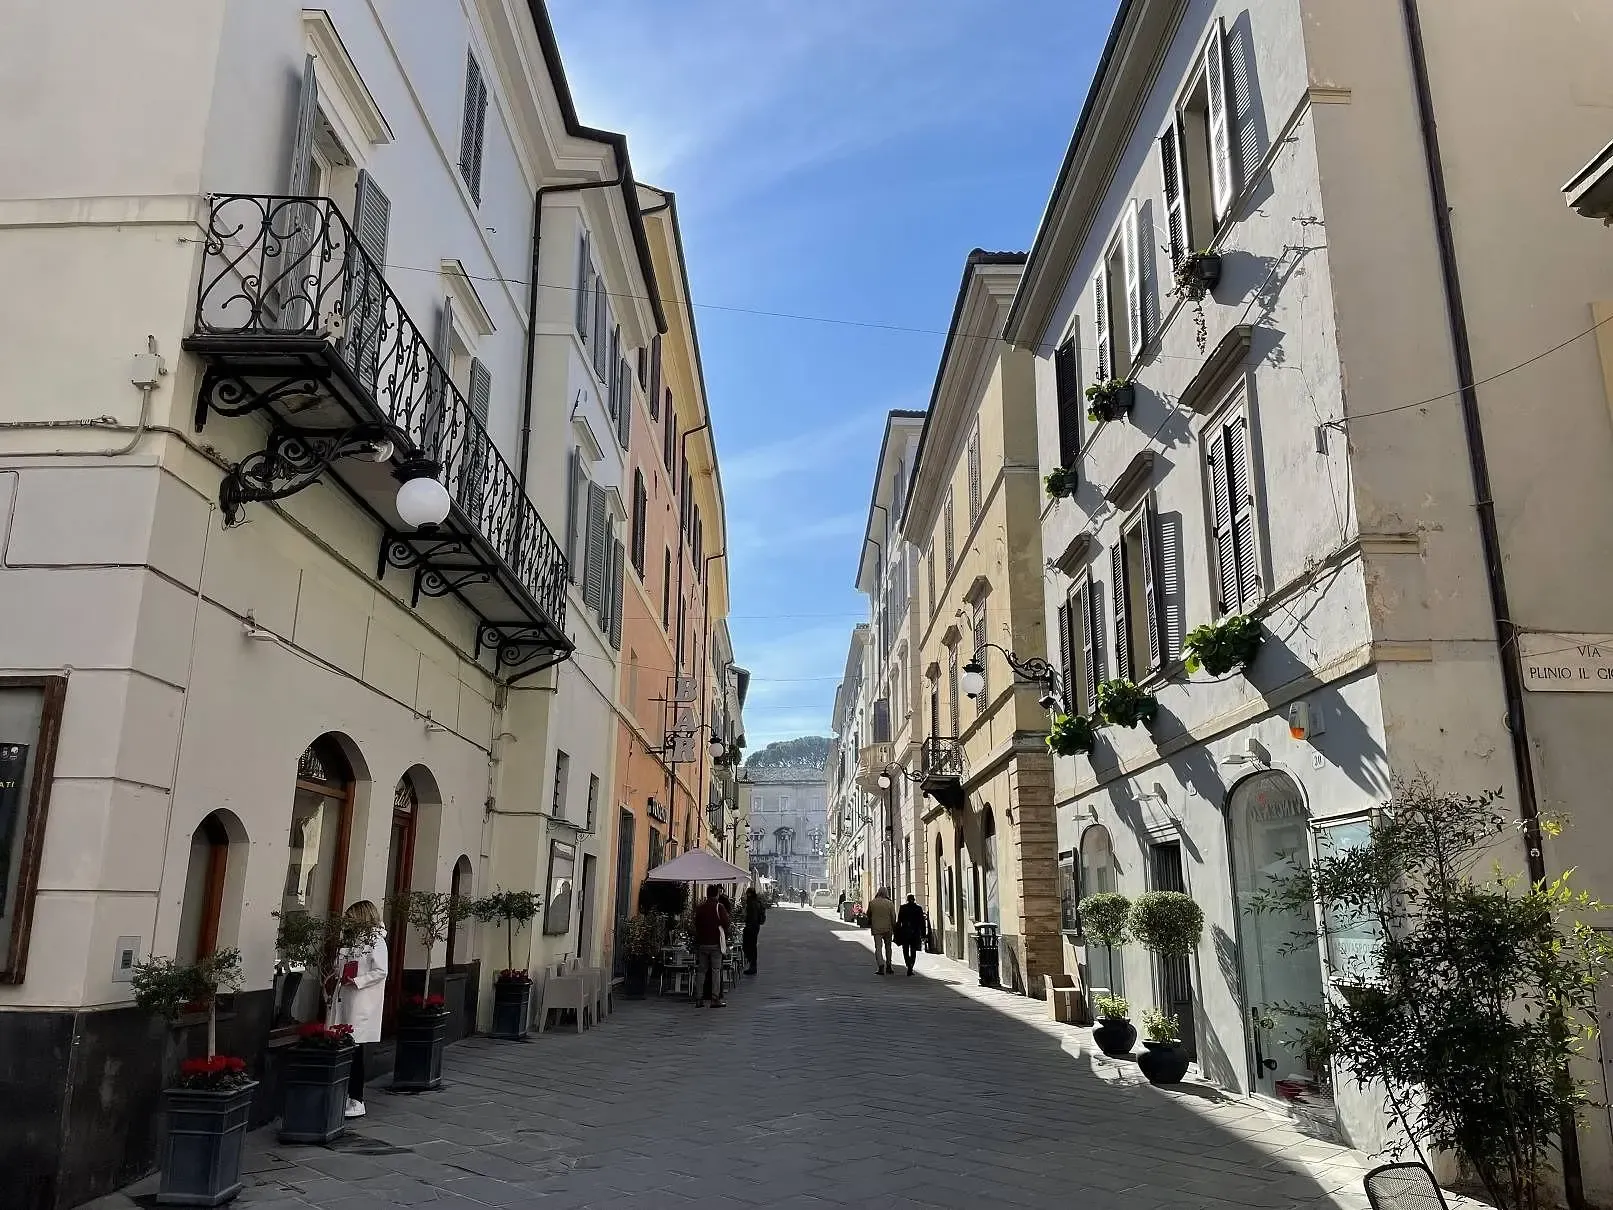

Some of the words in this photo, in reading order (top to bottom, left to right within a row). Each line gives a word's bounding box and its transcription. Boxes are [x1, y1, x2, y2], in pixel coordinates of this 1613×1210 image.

[1577, 644, 1601, 658] VIA
[1530, 666, 1572, 679] PLINIO
[1578, 667, 1590, 680] IL
[1597, 667, 1613, 680] GI
[673, 677, 697, 761] BAR
